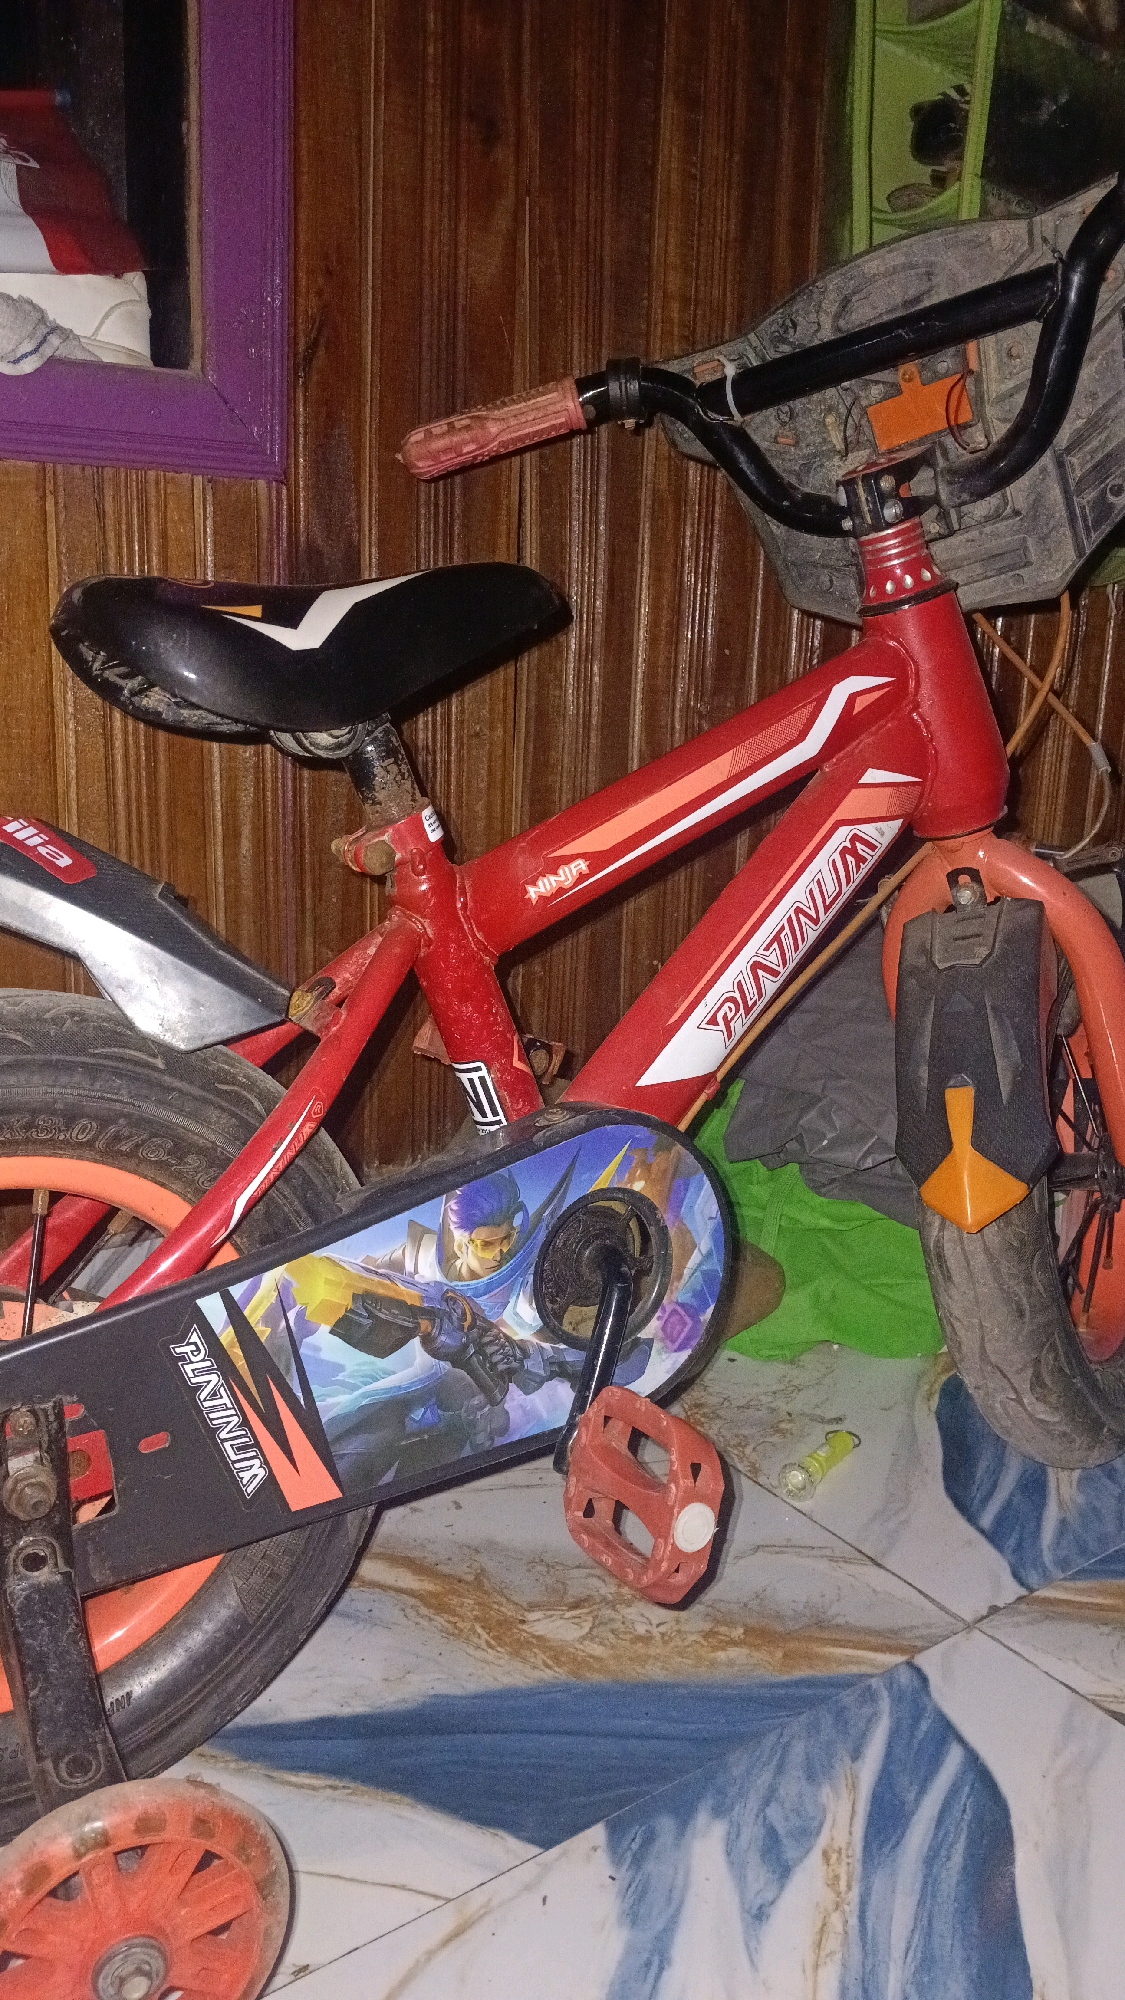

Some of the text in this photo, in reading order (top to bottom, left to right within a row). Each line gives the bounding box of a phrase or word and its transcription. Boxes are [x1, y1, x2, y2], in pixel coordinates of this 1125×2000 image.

[2, 816, 73, 868] ilia
[527, 859, 587, 900] NINJA
[697, 828, 883, 1048] PLATINUM
[171, 1324, 269, 1499] PLATINUM
